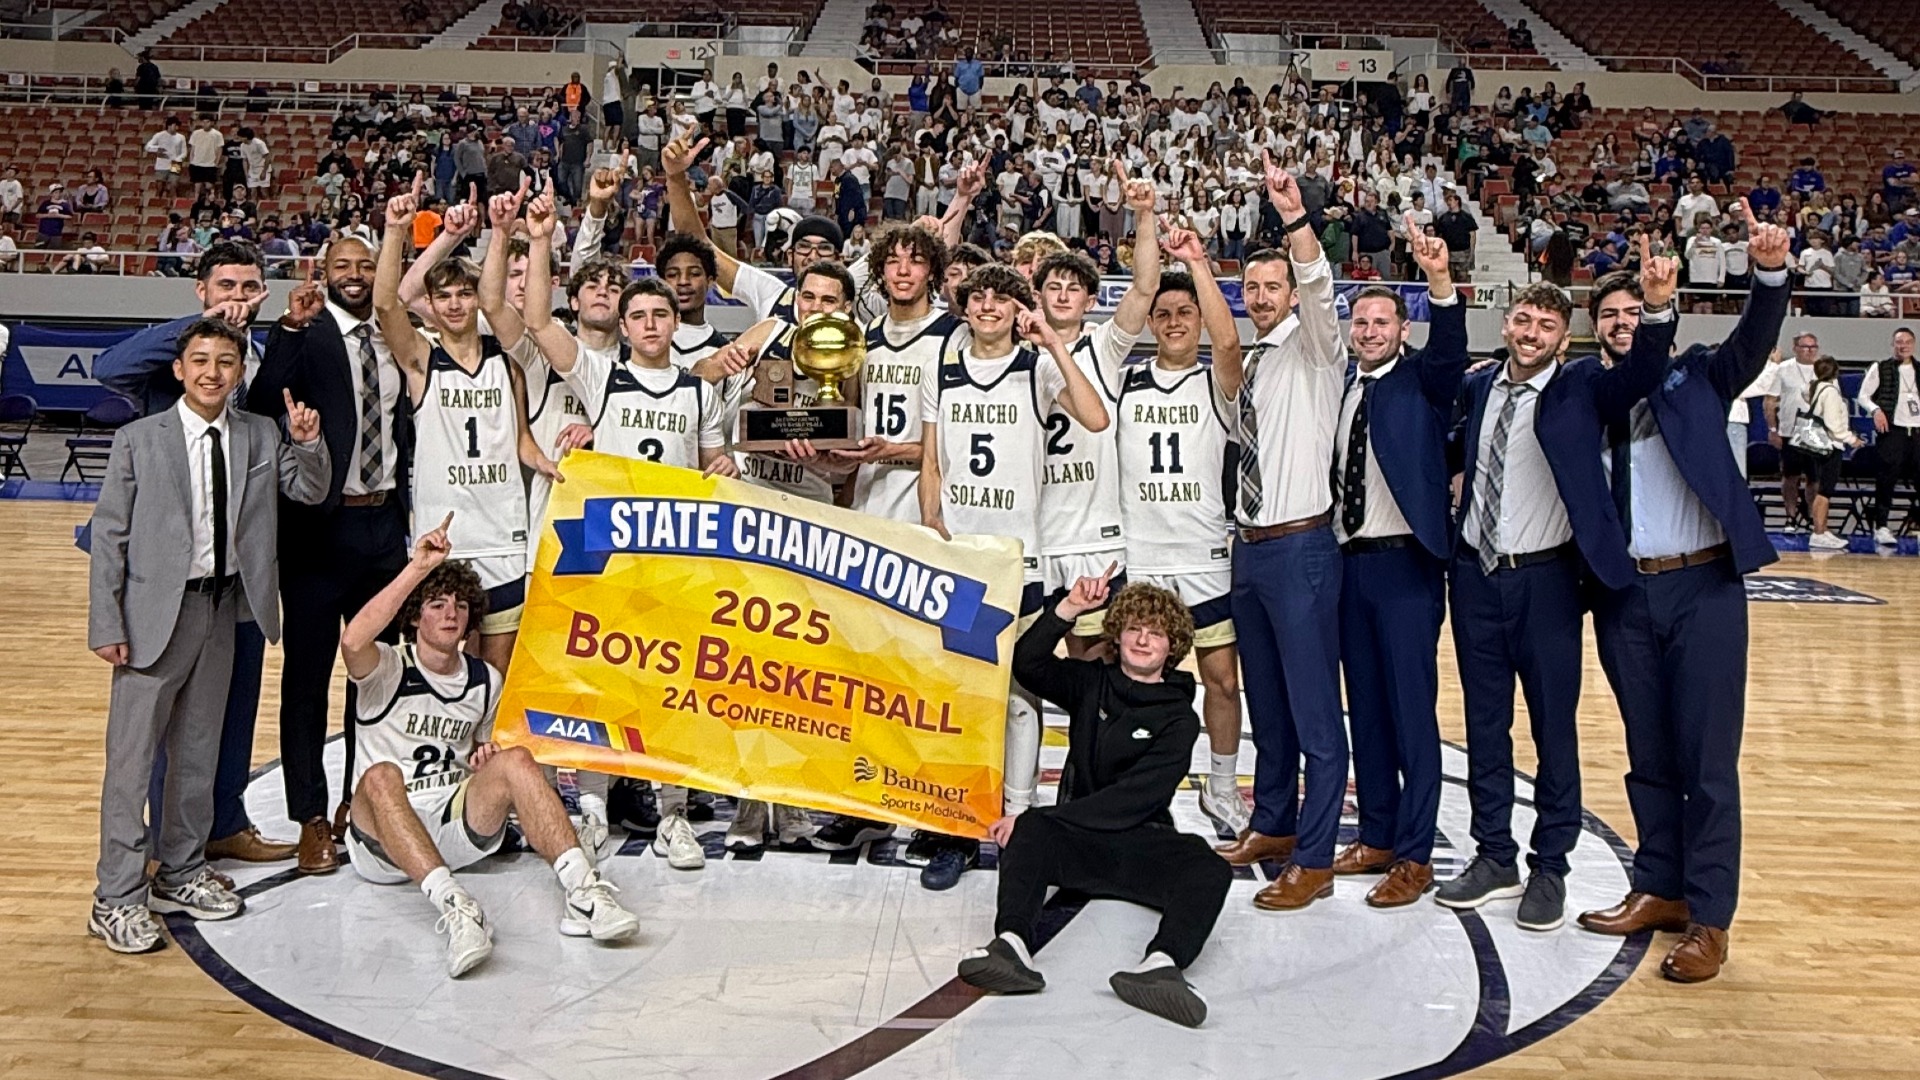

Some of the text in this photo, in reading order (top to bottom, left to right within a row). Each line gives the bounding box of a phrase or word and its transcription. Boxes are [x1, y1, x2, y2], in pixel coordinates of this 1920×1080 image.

[690, 46, 707, 60] 12
[1358, 58, 1377, 73] 13
[1477, 288, 1494, 302] 214
[866, 364, 921, 386] RANCHO
[441, 388, 502, 408] RANCHO
[620, 407, 687, 433] RANCHO
[874, 392, 907, 436] 15
[951, 402, 1018, 425] RANCHO
[1134, 404, 1199, 424] RANCHO
[465, 417, 481, 458] 1
[969, 432, 995, 477] 5
[1149, 432, 1183, 474] 11
[448, 463, 507, 485] SOLANO
[742, 457, 804, 484] SOLANO
[950, 484, 1015, 510] SOLANO
[1138, 482, 1201, 502] SOLANO
[610, 501, 954, 620] STATE CHAMPIONS
[711, 589, 830, 645] 2025
[565, 610, 962, 734] BOYS BASKETBALL
[405, 713, 472, 740] RANCHO
[661, 686, 852, 743] 2A CONFERENCE
[545, 717, 592, 741] AIA
[881, 765, 969, 803] Banner
[880, 793, 977, 824] Sports Medicine
